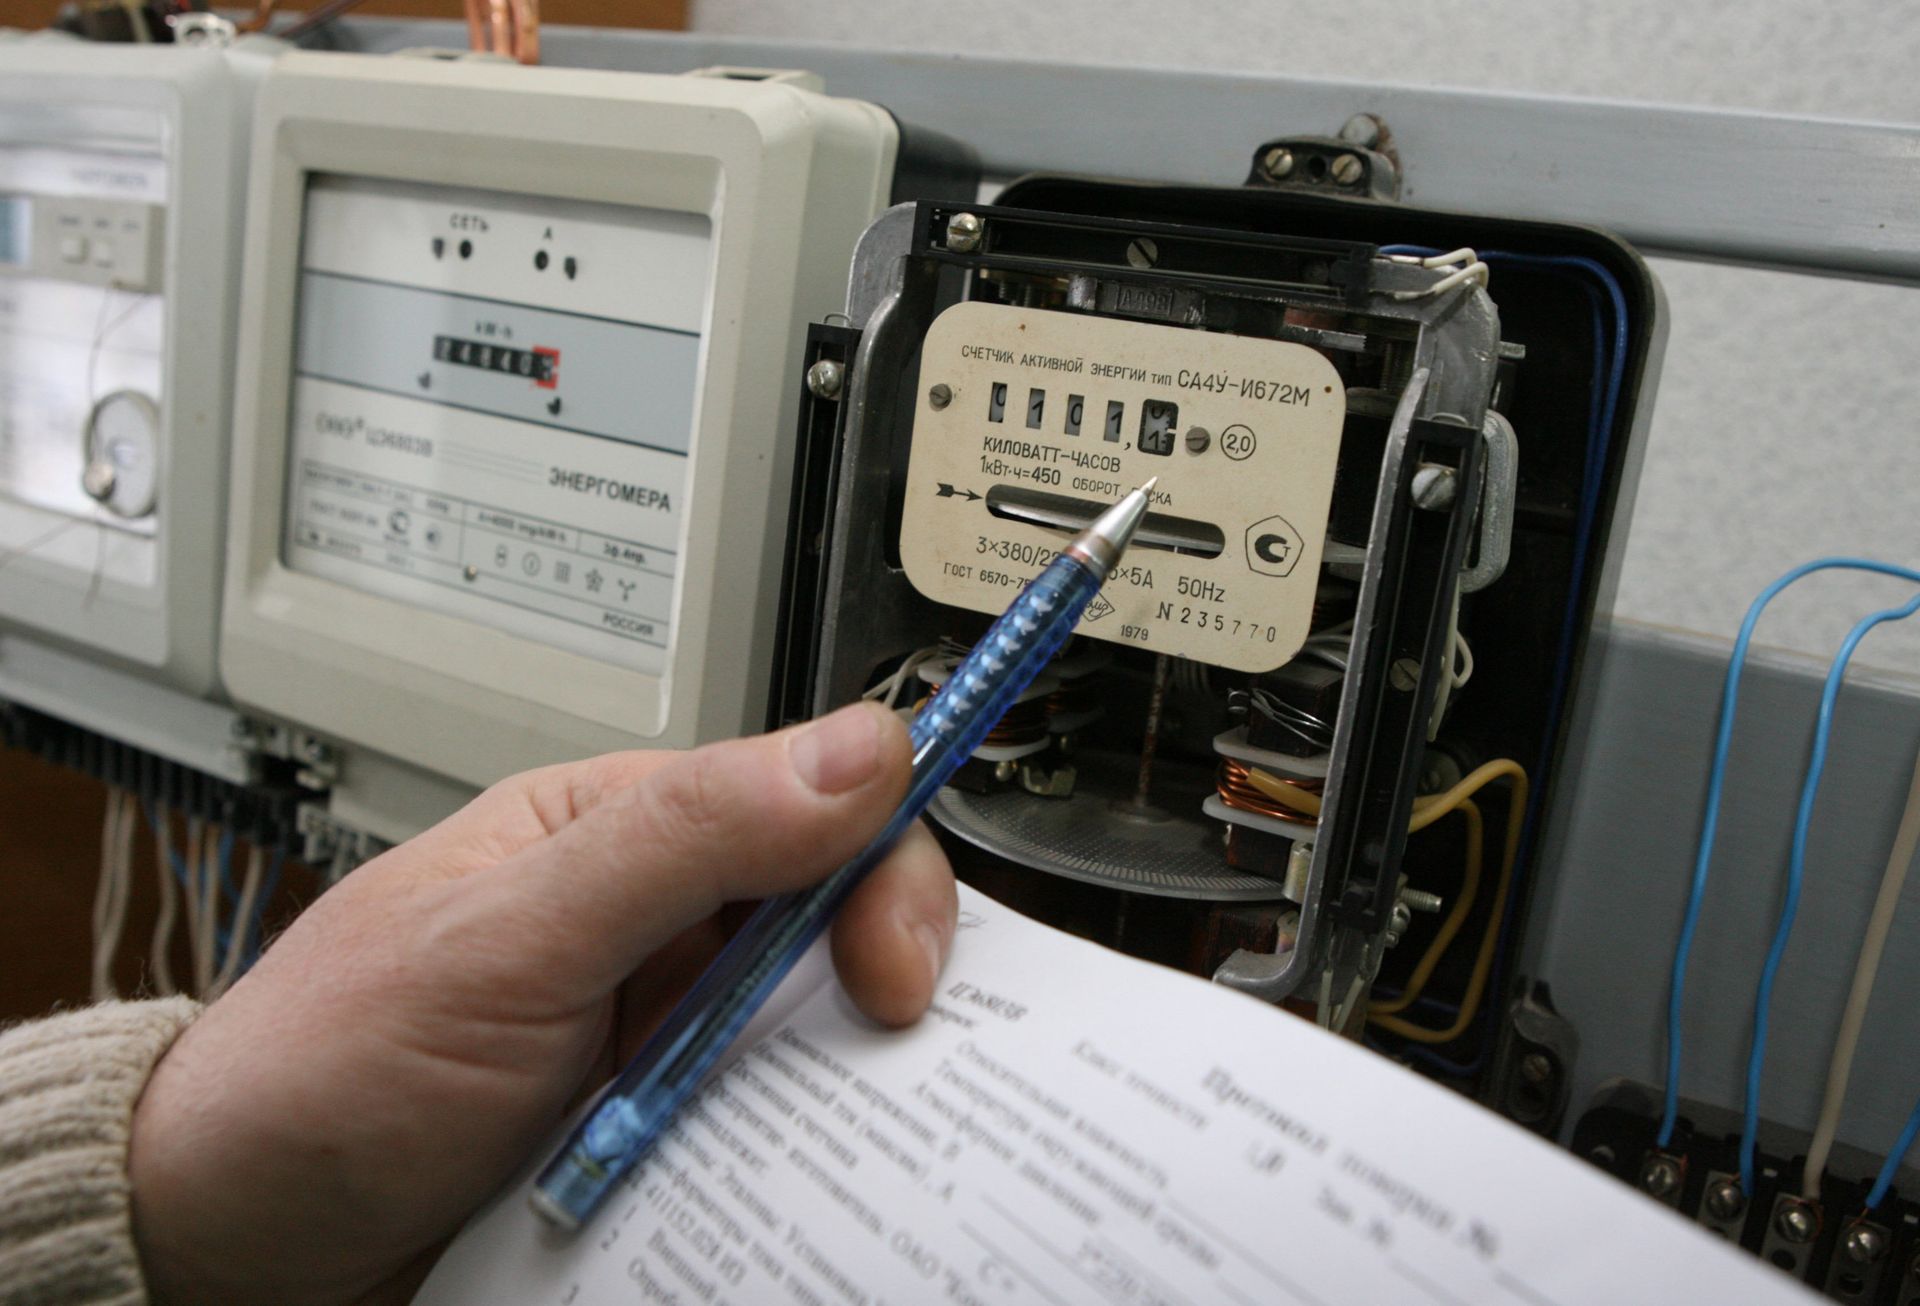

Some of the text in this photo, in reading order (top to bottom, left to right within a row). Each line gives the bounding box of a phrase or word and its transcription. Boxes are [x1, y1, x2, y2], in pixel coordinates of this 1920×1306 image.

[962, 345, 1014, 364] СЧЕТЧИК
[1020, 354, 1083, 373] АКТИВНОЙ
[1090, 363, 1146, 382] ЭНЕРГИИ
[983, 436, 1121, 473] КИЛОВАТТ-ЧАСОВ
[1226, 433, 1251, 454] 2,0
[549, 467, 671, 512] ЭНЕРГОМЕРА
[944, 562, 973, 579] ГОСТ
[1177, 575, 1226, 603] 50Hz
[603, 612, 654, 636] РОССИЯ
[1120, 624, 1149, 641] 1979
